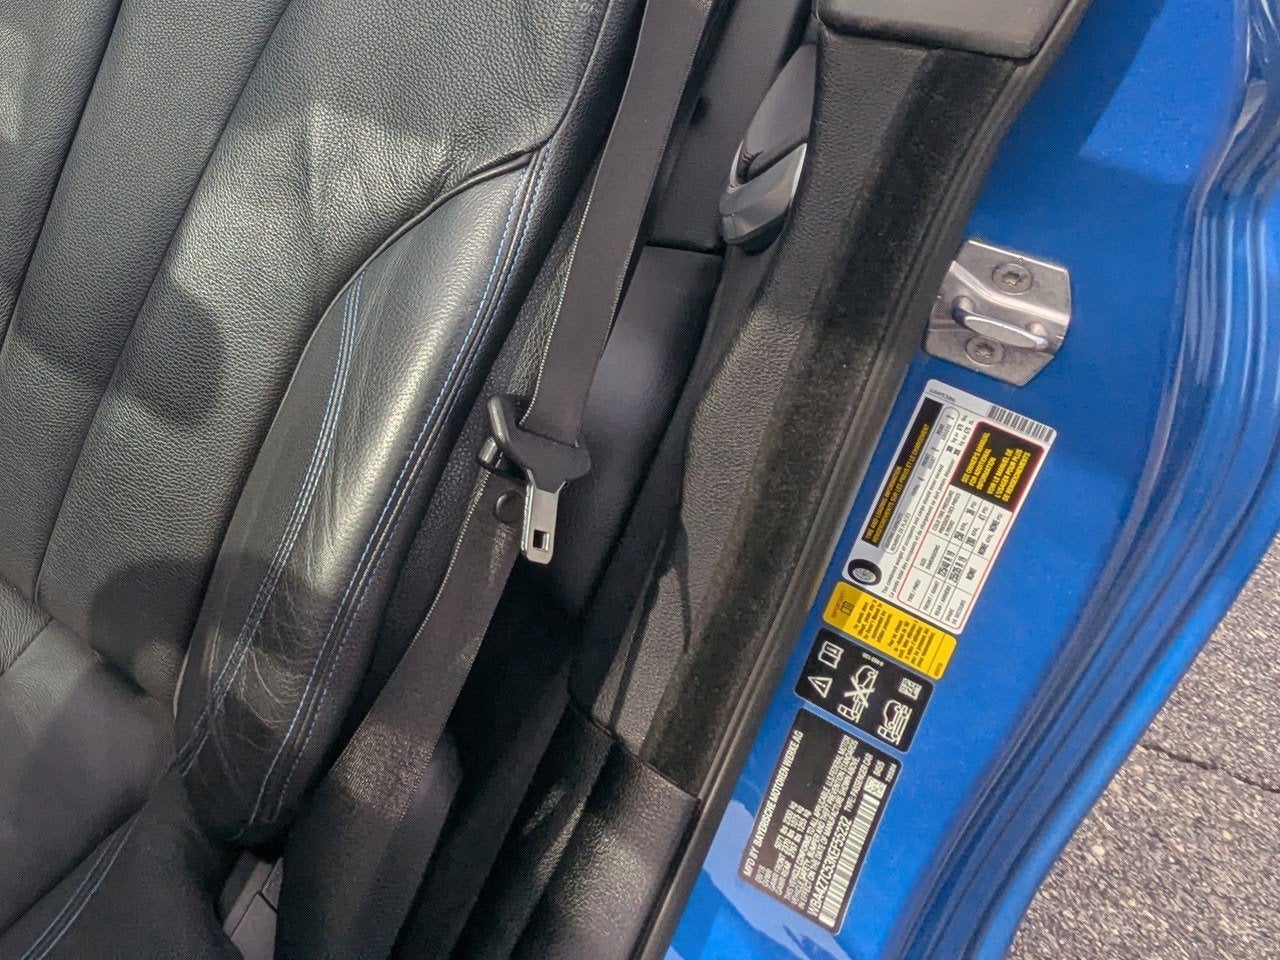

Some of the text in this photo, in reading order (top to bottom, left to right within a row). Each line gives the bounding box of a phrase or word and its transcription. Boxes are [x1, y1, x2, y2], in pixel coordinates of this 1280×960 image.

[742, 729, 803, 877] MFD BY BAYERISCHE MOTOREN WERKE AG
[849, 762, 869, 798] PASSENGER
[861, 751, 874, 767] CAR
[805, 814, 852, 918] WBA4Z7C53KEF55232
